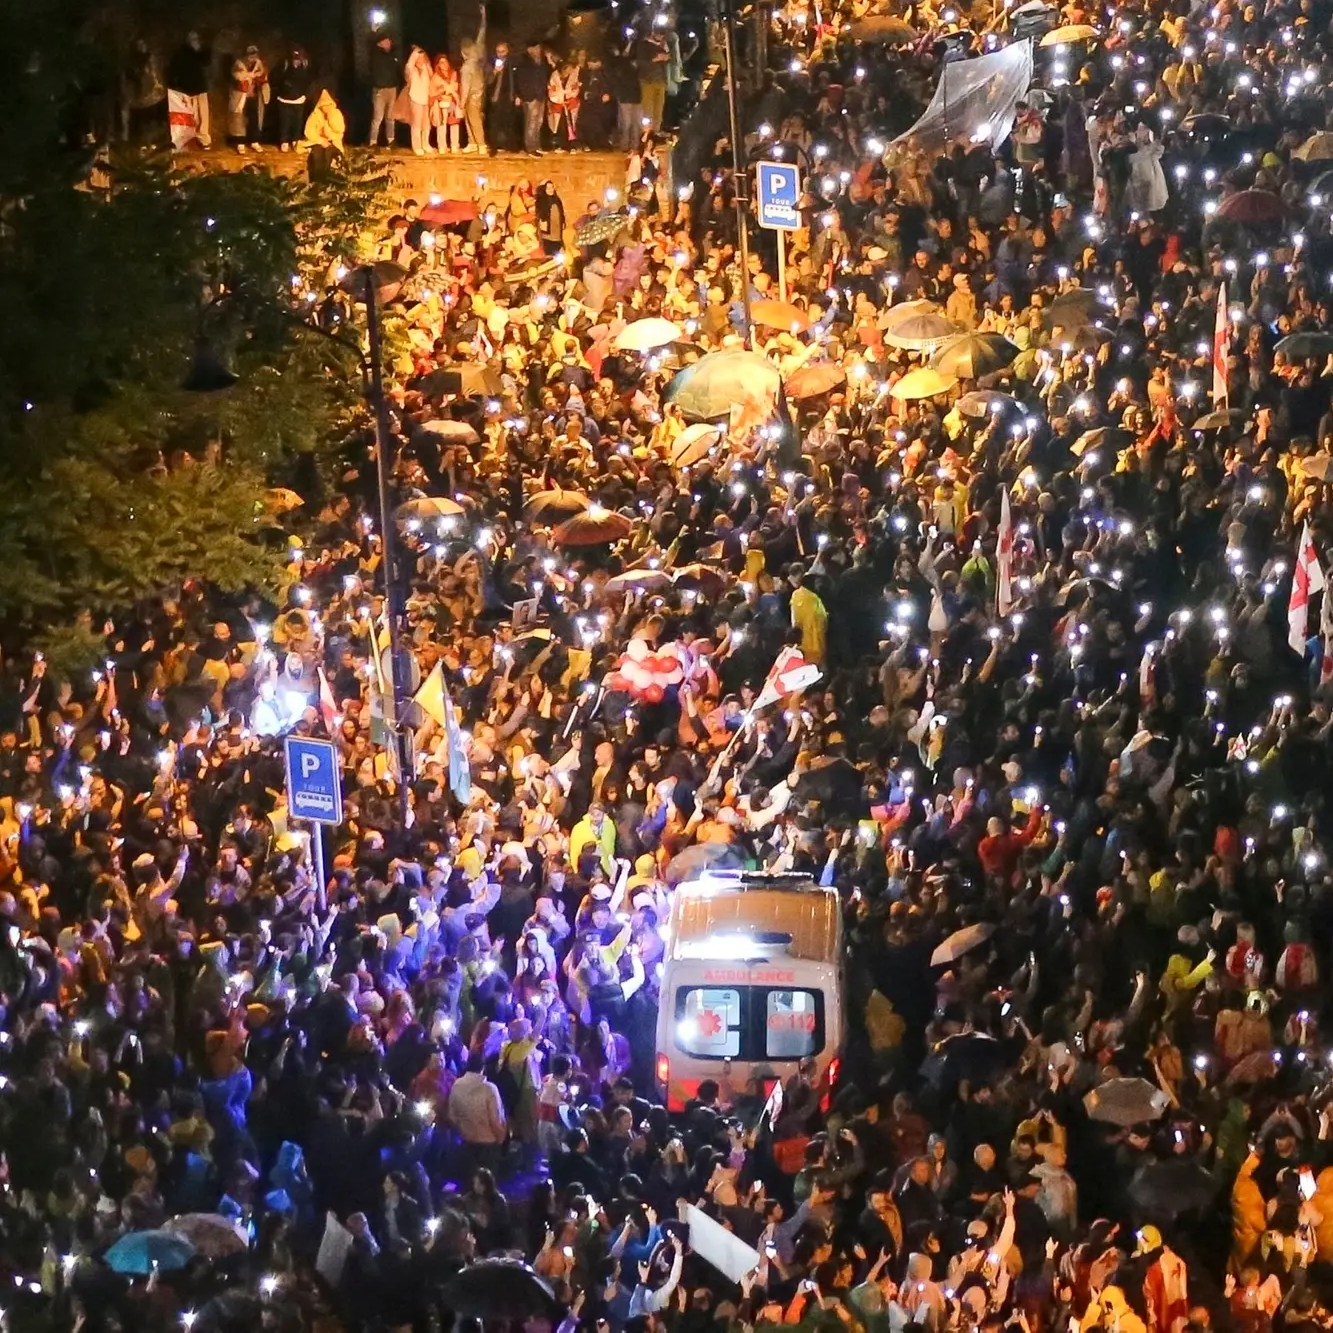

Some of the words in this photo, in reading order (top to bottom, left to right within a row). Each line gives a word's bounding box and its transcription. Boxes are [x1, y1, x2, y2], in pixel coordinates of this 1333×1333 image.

[771, 174, 786, 194] P
[301, 753, 320, 778] P
[704, 970, 794, 982] AMBULANCE
[788, 1013, 815, 1031] 112
